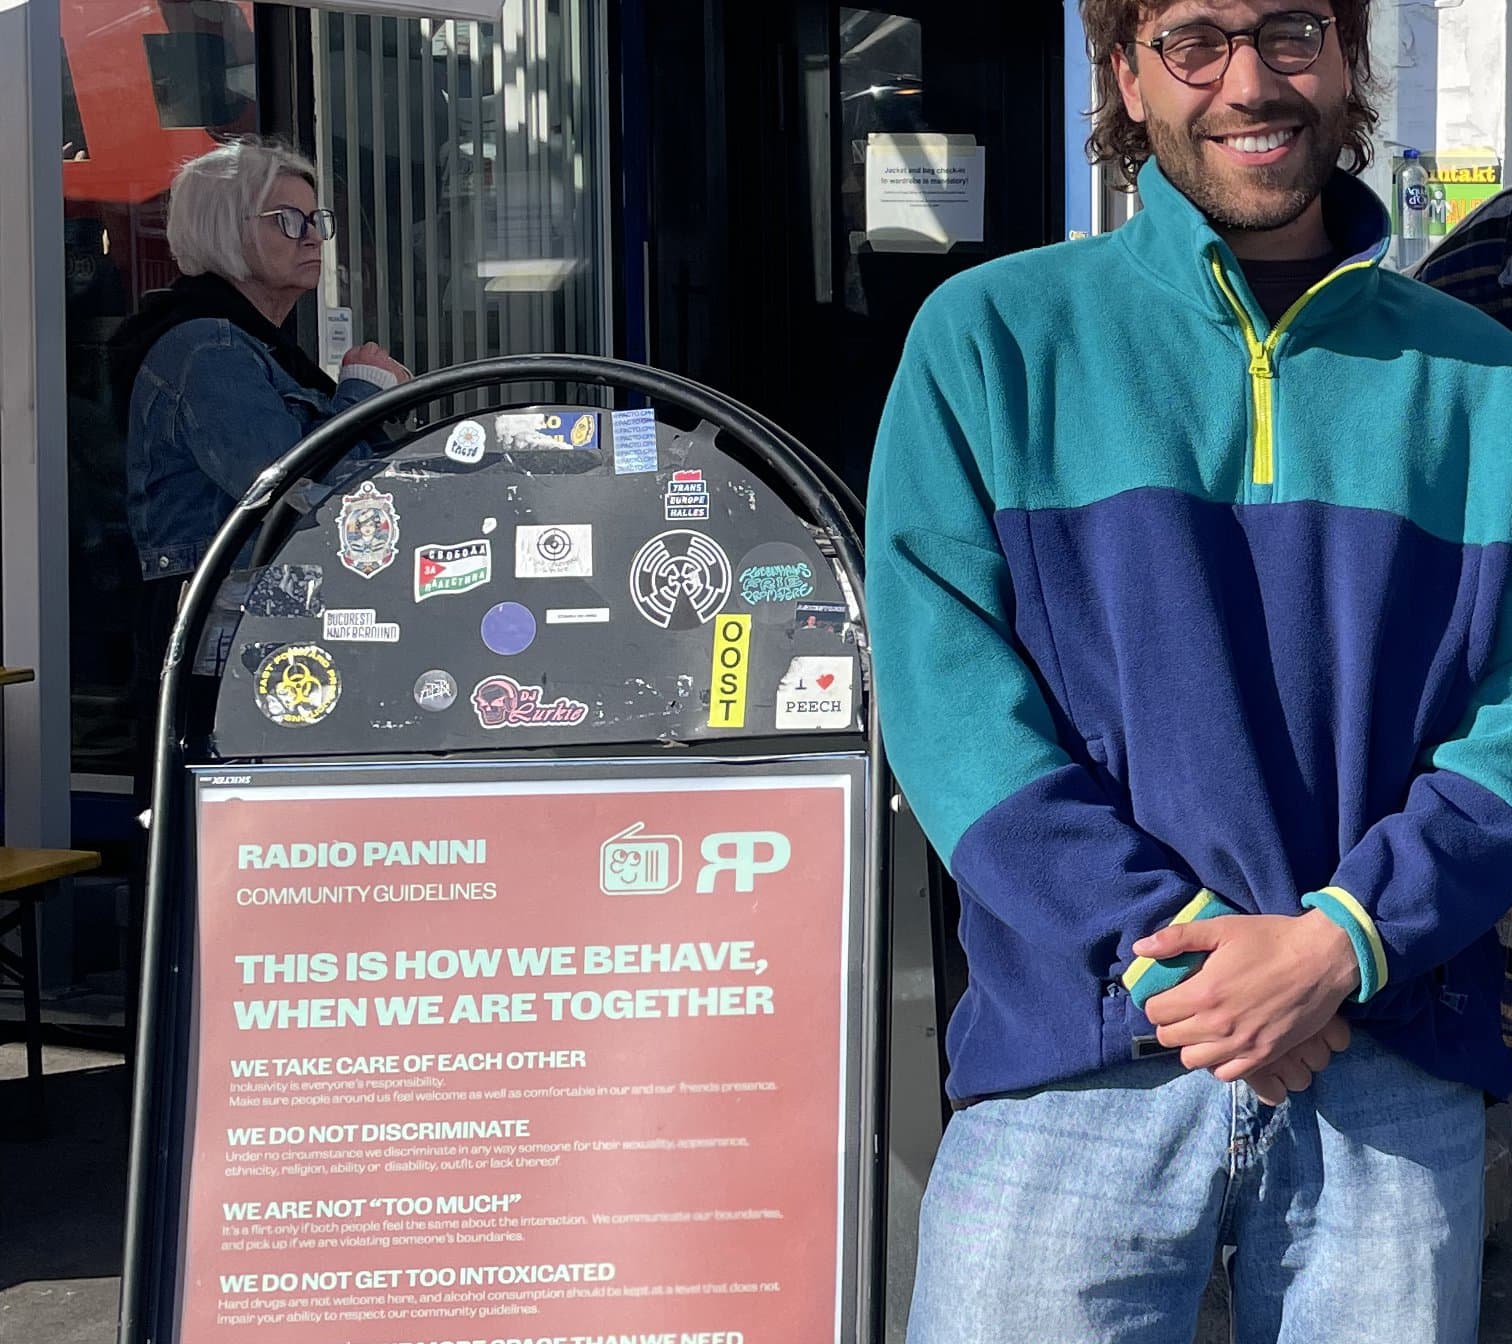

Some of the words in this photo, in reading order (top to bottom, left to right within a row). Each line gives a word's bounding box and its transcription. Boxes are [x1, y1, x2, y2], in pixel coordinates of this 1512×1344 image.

[672, 483, 702, 492] TRANS
[670, 495, 705, 505] EUROPE
[670, 508, 705, 517] HALLES
[429, 545, 486, 560] СВОБОДА
[424, 565, 436, 575] ЗА
[425, 570, 485, 592] ПАЛЕСТИНА
[719, 621, 743, 721] OOST
[520, 690, 538, 702] DJ
[785, 700, 842, 713] PEECH
[239, 840, 356, 869] RADIO
[364, 839, 486, 866] PANINI
[237, 886, 370, 905] COMMUNITY
[373, 883, 496, 902] GUIDELINES
[235, 953, 338, 983] THIS
[346, 952, 388, 981] IS
[396, 949, 502, 979] HOW
[507, 947, 576, 976] WE
[584, 941, 768, 975] BEHAVE,
[234, 998, 367, 1029] WHEN
[374, 996, 444, 1025] WE
[449, 993, 537, 1023] ARE
[544, 986, 774, 1020] TOGETHER
[231, 1060, 269, 1077] WE
[272, 1058, 332, 1076] TAKE
[336, 1056, 400, 1074] CARE
[404, 1055, 435, 1072] OF
[438, 1053, 502, 1071] EACH
[507, 1051, 586, 1069] OTHER
[228, 1128, 265, 1145] WE
[269, 1127, 304, 1144] DO
[309, 1125, 359, 1143] NOT
[362, 1120, 530, 1141] DISCRIMINATE
[223, 1203, 261, 1220] WE
[264, 1201, 312, 1219] ARE
[317, 1199, 367, 1217] NOT
[370, 1197, 432, 1215] “TOO
[437, 1194, 521, 1214] MUCH”
[220, 1275, 258, 1293] WE
[262, 1274, 298, 1292] DO
[302, 1272, 352, 1290] NOT
[355, 1270, 403, 1288] GET
[405, 1268, 456, 1286] TOO
[460, 1263, 615, 1285] INTOXICATED
